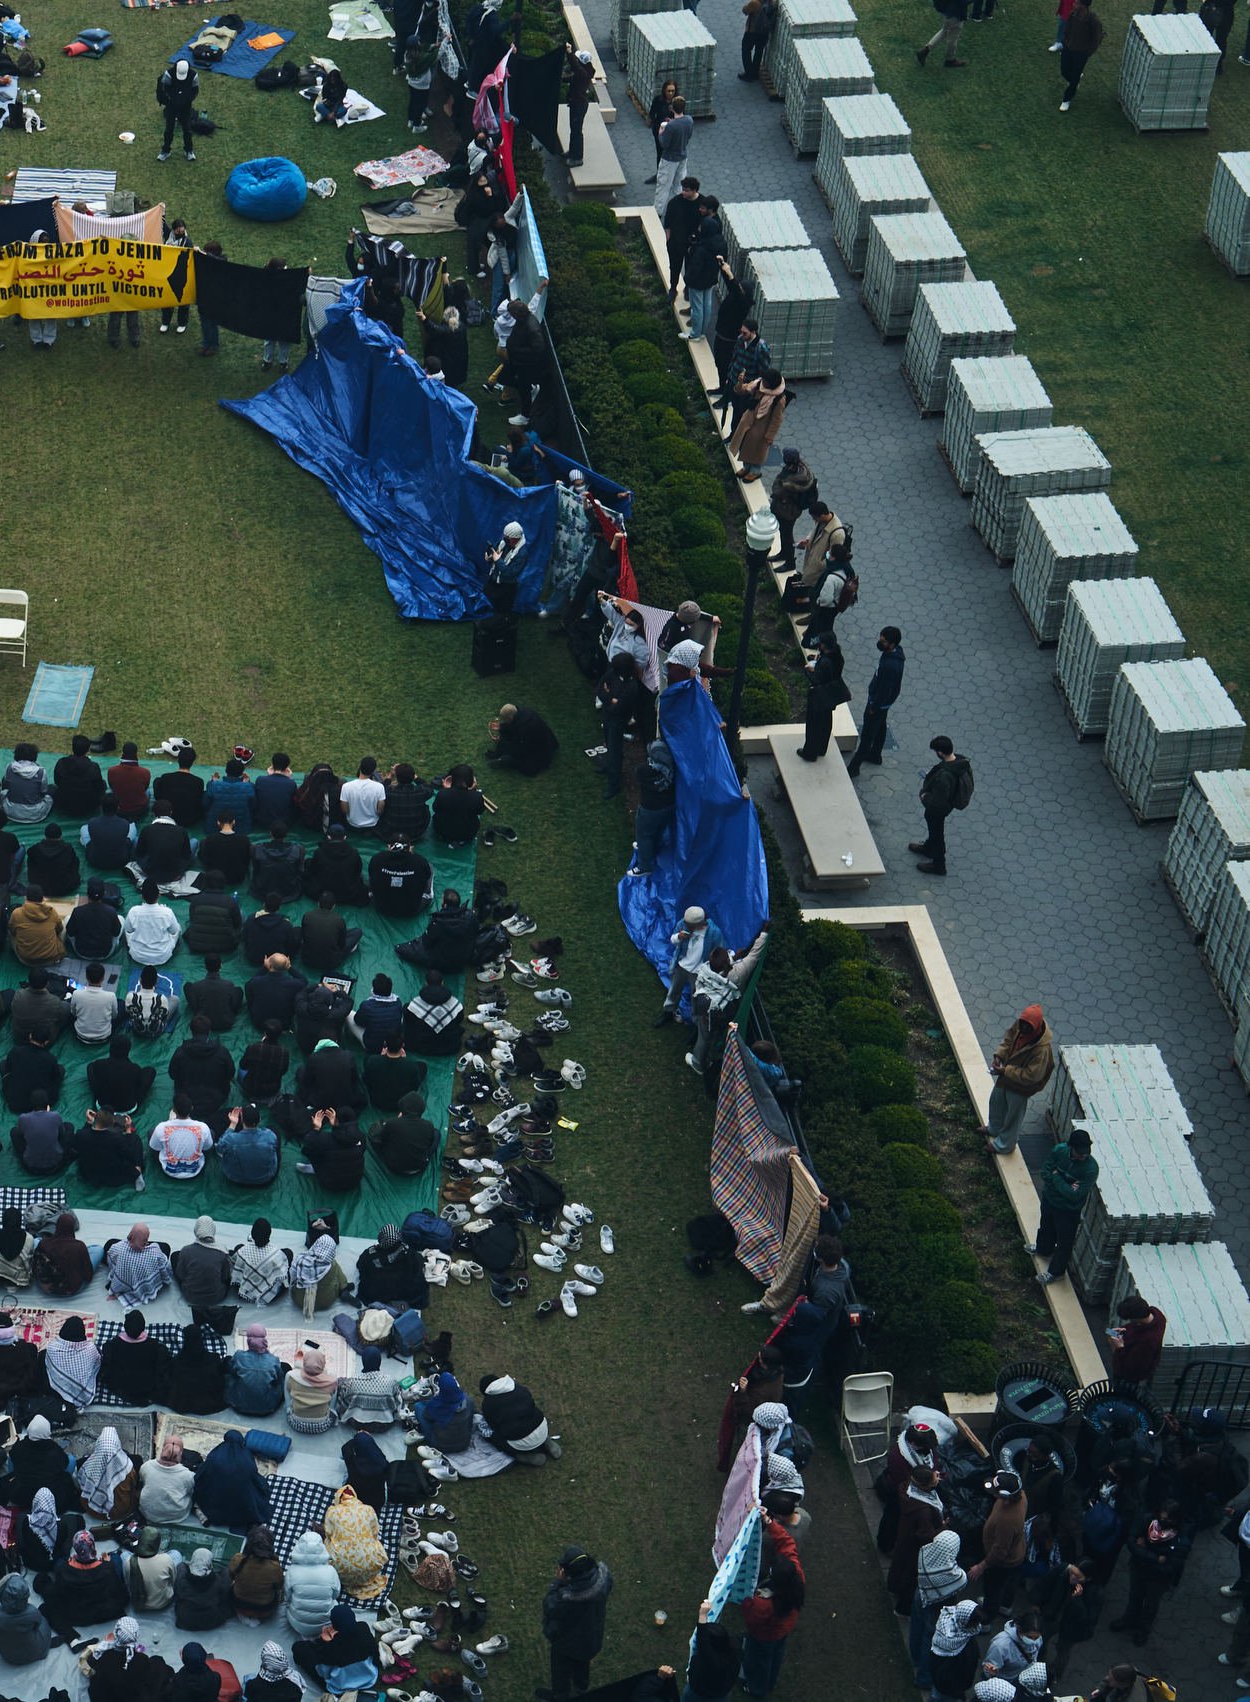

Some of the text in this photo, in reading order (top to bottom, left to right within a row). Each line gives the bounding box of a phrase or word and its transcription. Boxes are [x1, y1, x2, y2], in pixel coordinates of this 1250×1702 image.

[45, 240, 84, 259] GAZA
[91, 238, 109, 256] TO
[116, 240, 162, 261] JENIN
[63, 262, 105, 282] حتى
[107, 260, 145, 282] ثورة
[72, 281, 107, 297] UNTIL
[112, 280, 164, 298] VICTORY
[46, 296, 111, 308] @wolpalestine
